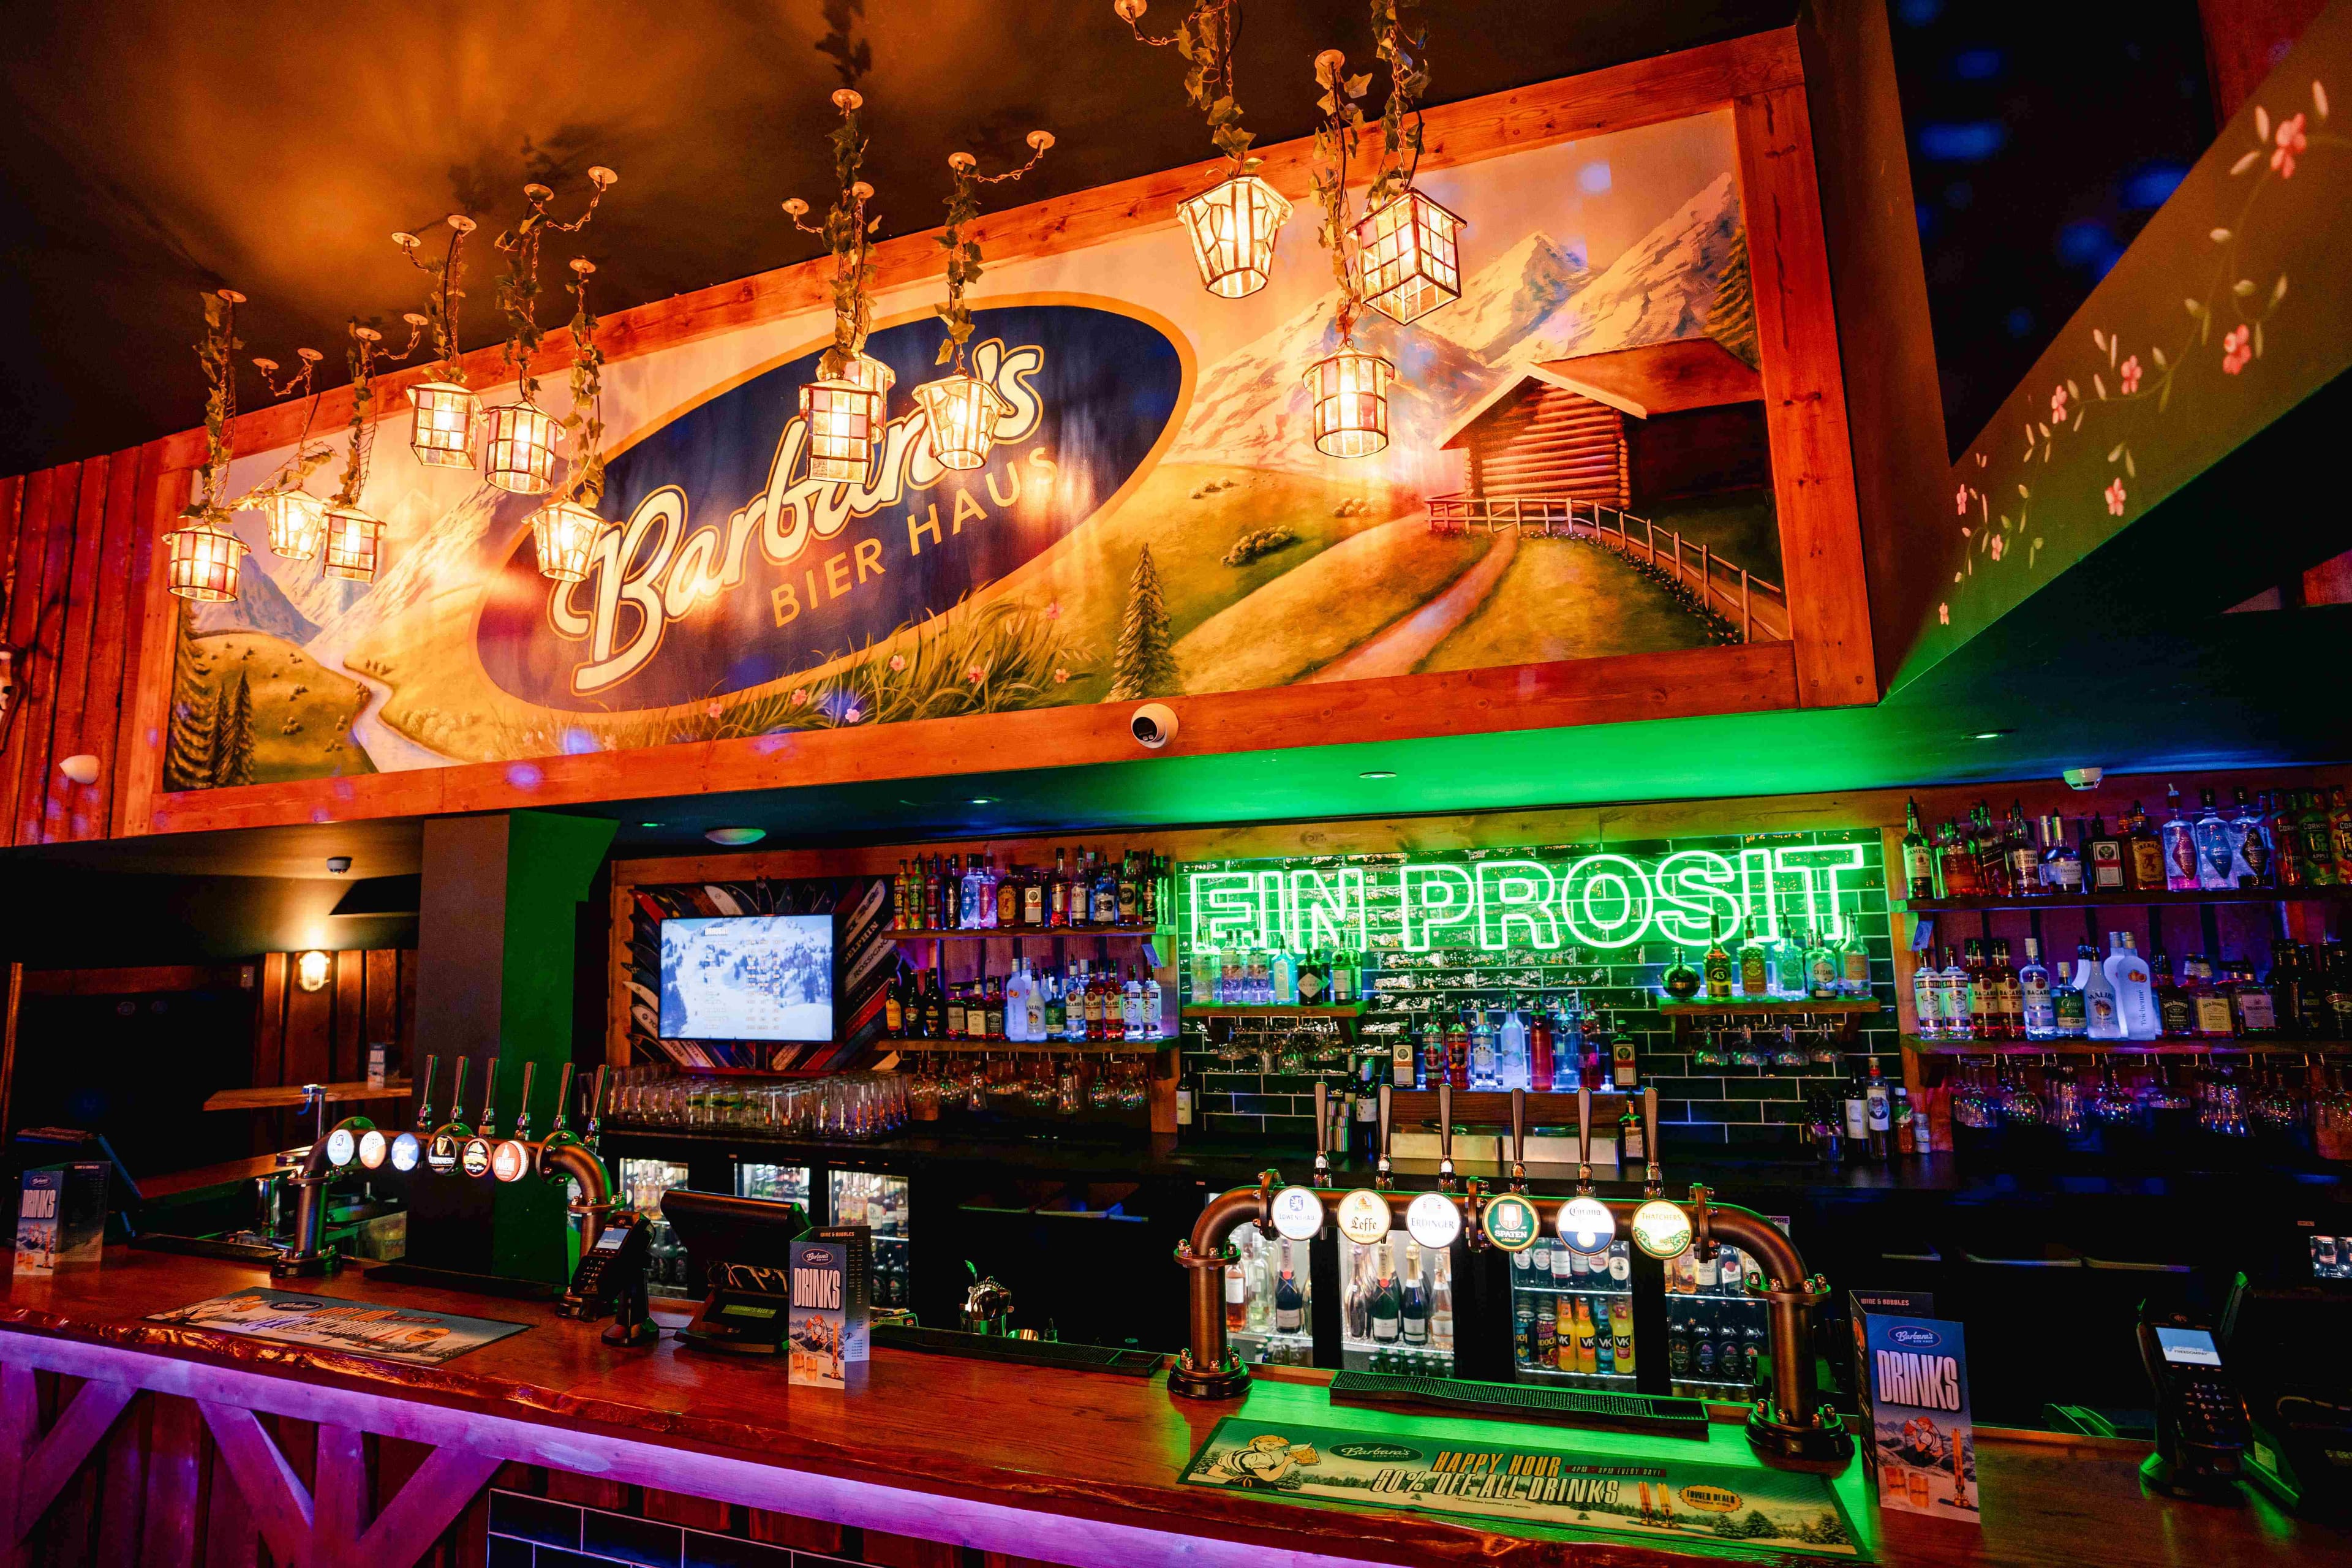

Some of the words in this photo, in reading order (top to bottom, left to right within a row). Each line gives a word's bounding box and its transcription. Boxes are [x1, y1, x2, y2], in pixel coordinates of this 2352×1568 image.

[770, 538, 886, 628] BIER
[907, 446, 1060, 556] HAUS
[1191, 868, 1366, 954] EIN
[1401, 844, 1863, 951] PROSIT
[853, 938, 888, 979] ROSSIGNO
[21, 1189, 56, 1218] DRINKS
[1569, 1207, 1602, 1216] Corona
[1641, 1212, 1682, 1221] THATCHERS
[1351, 1216, 1378, 1231] Leffe
[1411, 1217, 1455, 1229] ERDINGER
[1494, 1230, 1528, 1238] SPATEN
[806, 1252, 829, 1261] Barbara's
[794, 1268, 841, 1310] DRINKS
[1558, 1335, 1569, 1345] VK
[1616, 1336, 1629, 1346] VK
[1896, 1330, 1934, 1341] Barbara's
[1581, 1337, 1594, 1347] VK
[1599, 1338, 1612, 1348] VK
[1876, 1349, 1960, 1411] DRINKS
[1341, 1447, 1411, 1457] Barbara's
[1432, 1451, 1505, 1474] HAPPY
[1509, 1455, 1562, 1477] HOUR
[1371, 1469, 1427, 1493] 50%
[1432, 1472, 1477, 1496] OFF
[1477, 1474, 1519, 1499] ALL
[1528, 1476, 1619, 1504] DRINKS
[1687, 1489, 1711, 1501] TOWER
[1713, 1492, 1735, 1504] DEALS
